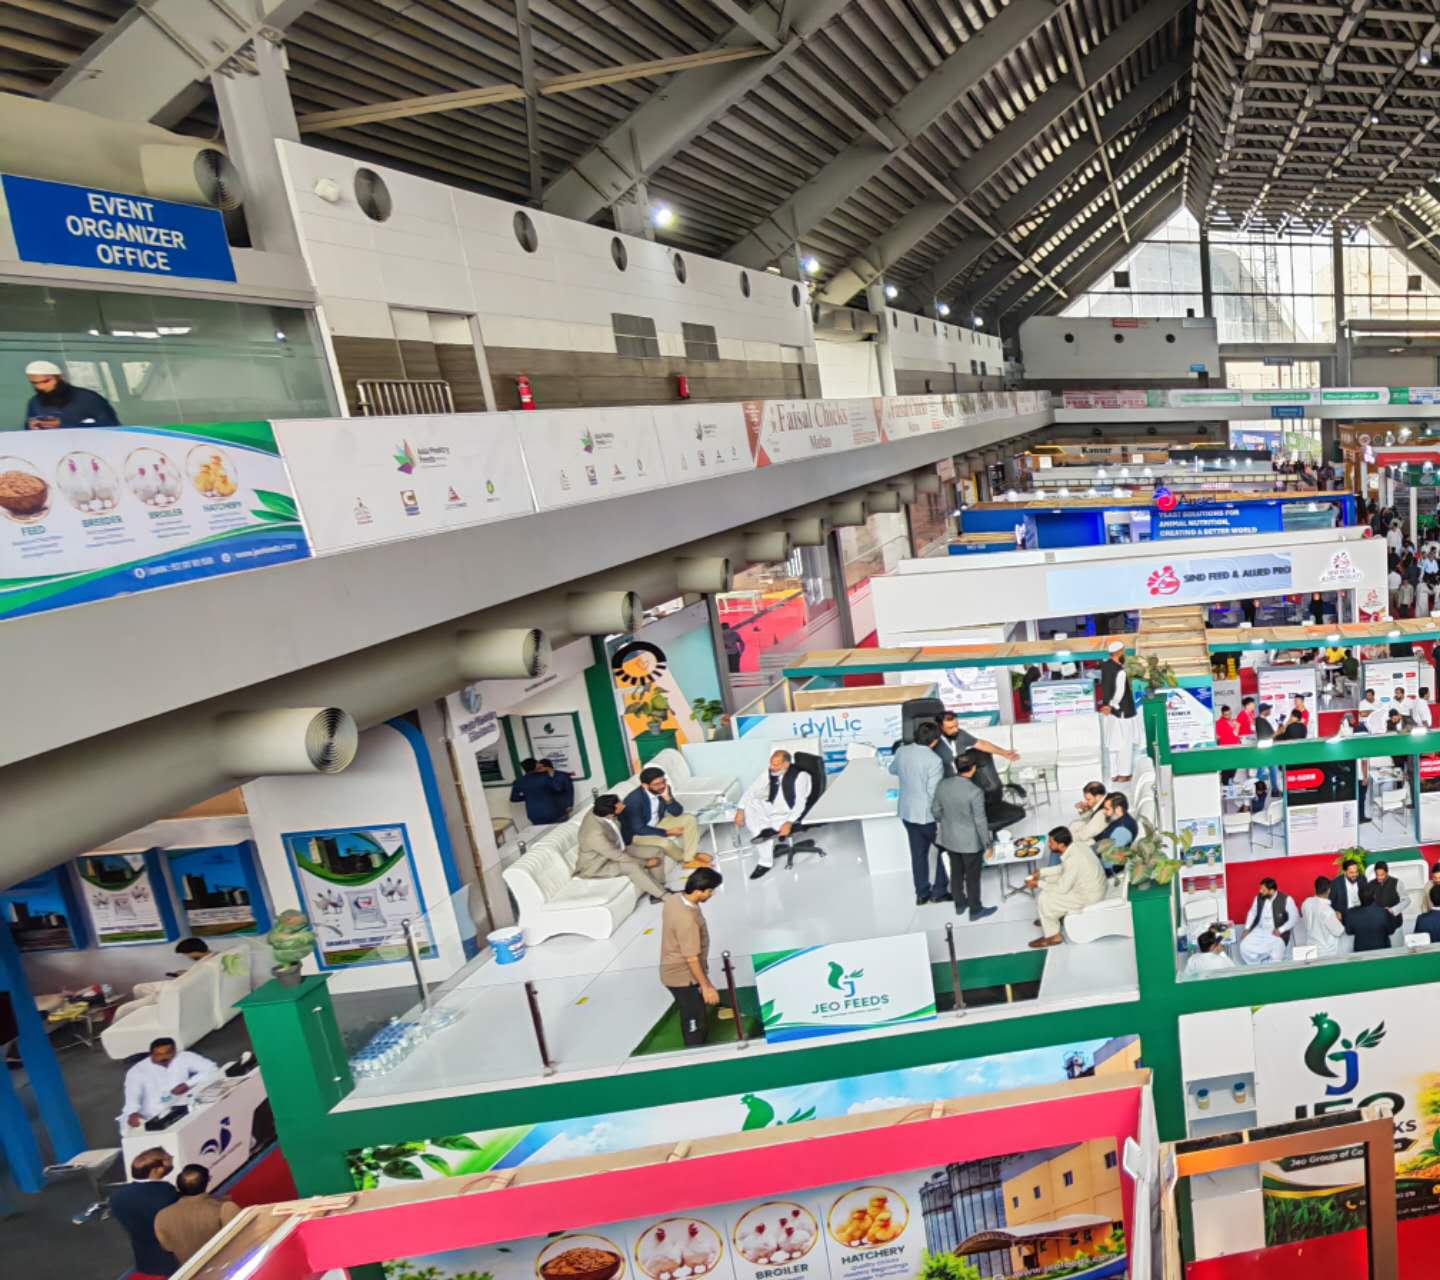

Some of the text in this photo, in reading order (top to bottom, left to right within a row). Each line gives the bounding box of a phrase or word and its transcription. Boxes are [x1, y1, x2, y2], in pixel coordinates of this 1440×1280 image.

[87, 192, 154, 222] EVENT
[65, 215, 187, 250] ORGANIZER
[96, 244, 172, 271] OFFICE
[202, 500, 243, 512] HATCHERY
[1225, 508, 1240, 516] FOR
[81, 514, 123, 528] BREEDER
[1159, 520, 1188, 528] ANIMAL
[21, 525, 46, 536] FEED
[1160, 529, 1197, 537] CREATING
[1204, 527, 1231, 535] BETTER
[1231, 526, 1258, 534] WORLD
[1183, 573, 1206, 583] SIND
[1208, 570, 1230, 581] FEED
[1232, 569, 1240, 578] &
[1242, 567, 1271, 578] ALLIED
[811, 993, 890, 1015] JEO FEEDS
[1290, 1157, 1308, 1168] Jeo
[1309, 1152, 1339, 1166] Group
[1339, 1148, 1350, 1158] of
[755, 1245, 905, 1280] BROILER HATCHERY
